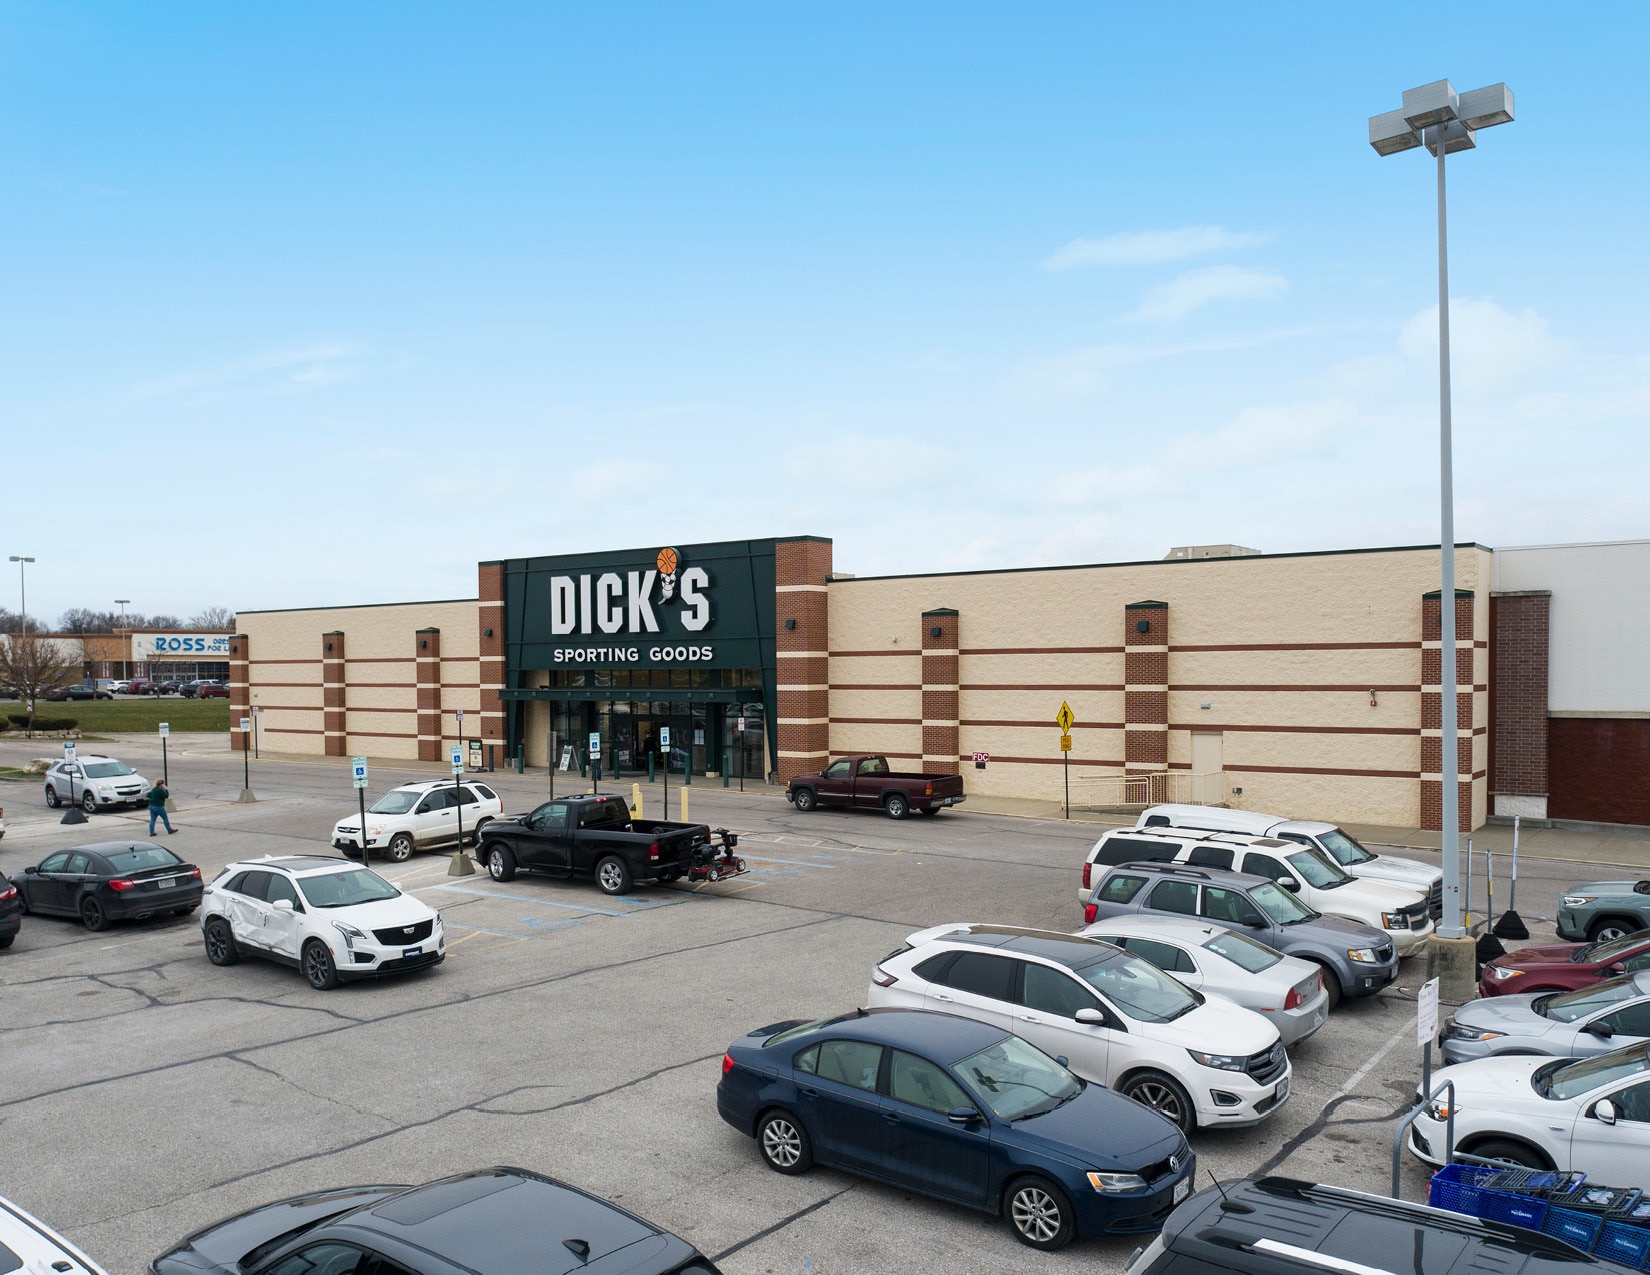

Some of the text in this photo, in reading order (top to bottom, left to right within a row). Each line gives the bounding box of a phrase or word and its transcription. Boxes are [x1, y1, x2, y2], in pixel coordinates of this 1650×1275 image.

[550, 566, 710, 635] DICK'S
[155, 637, 205, 651] ROSS
[553, 646, 713, 663] SPORTING GOODS
[973, 753, 988, 761] FDC
